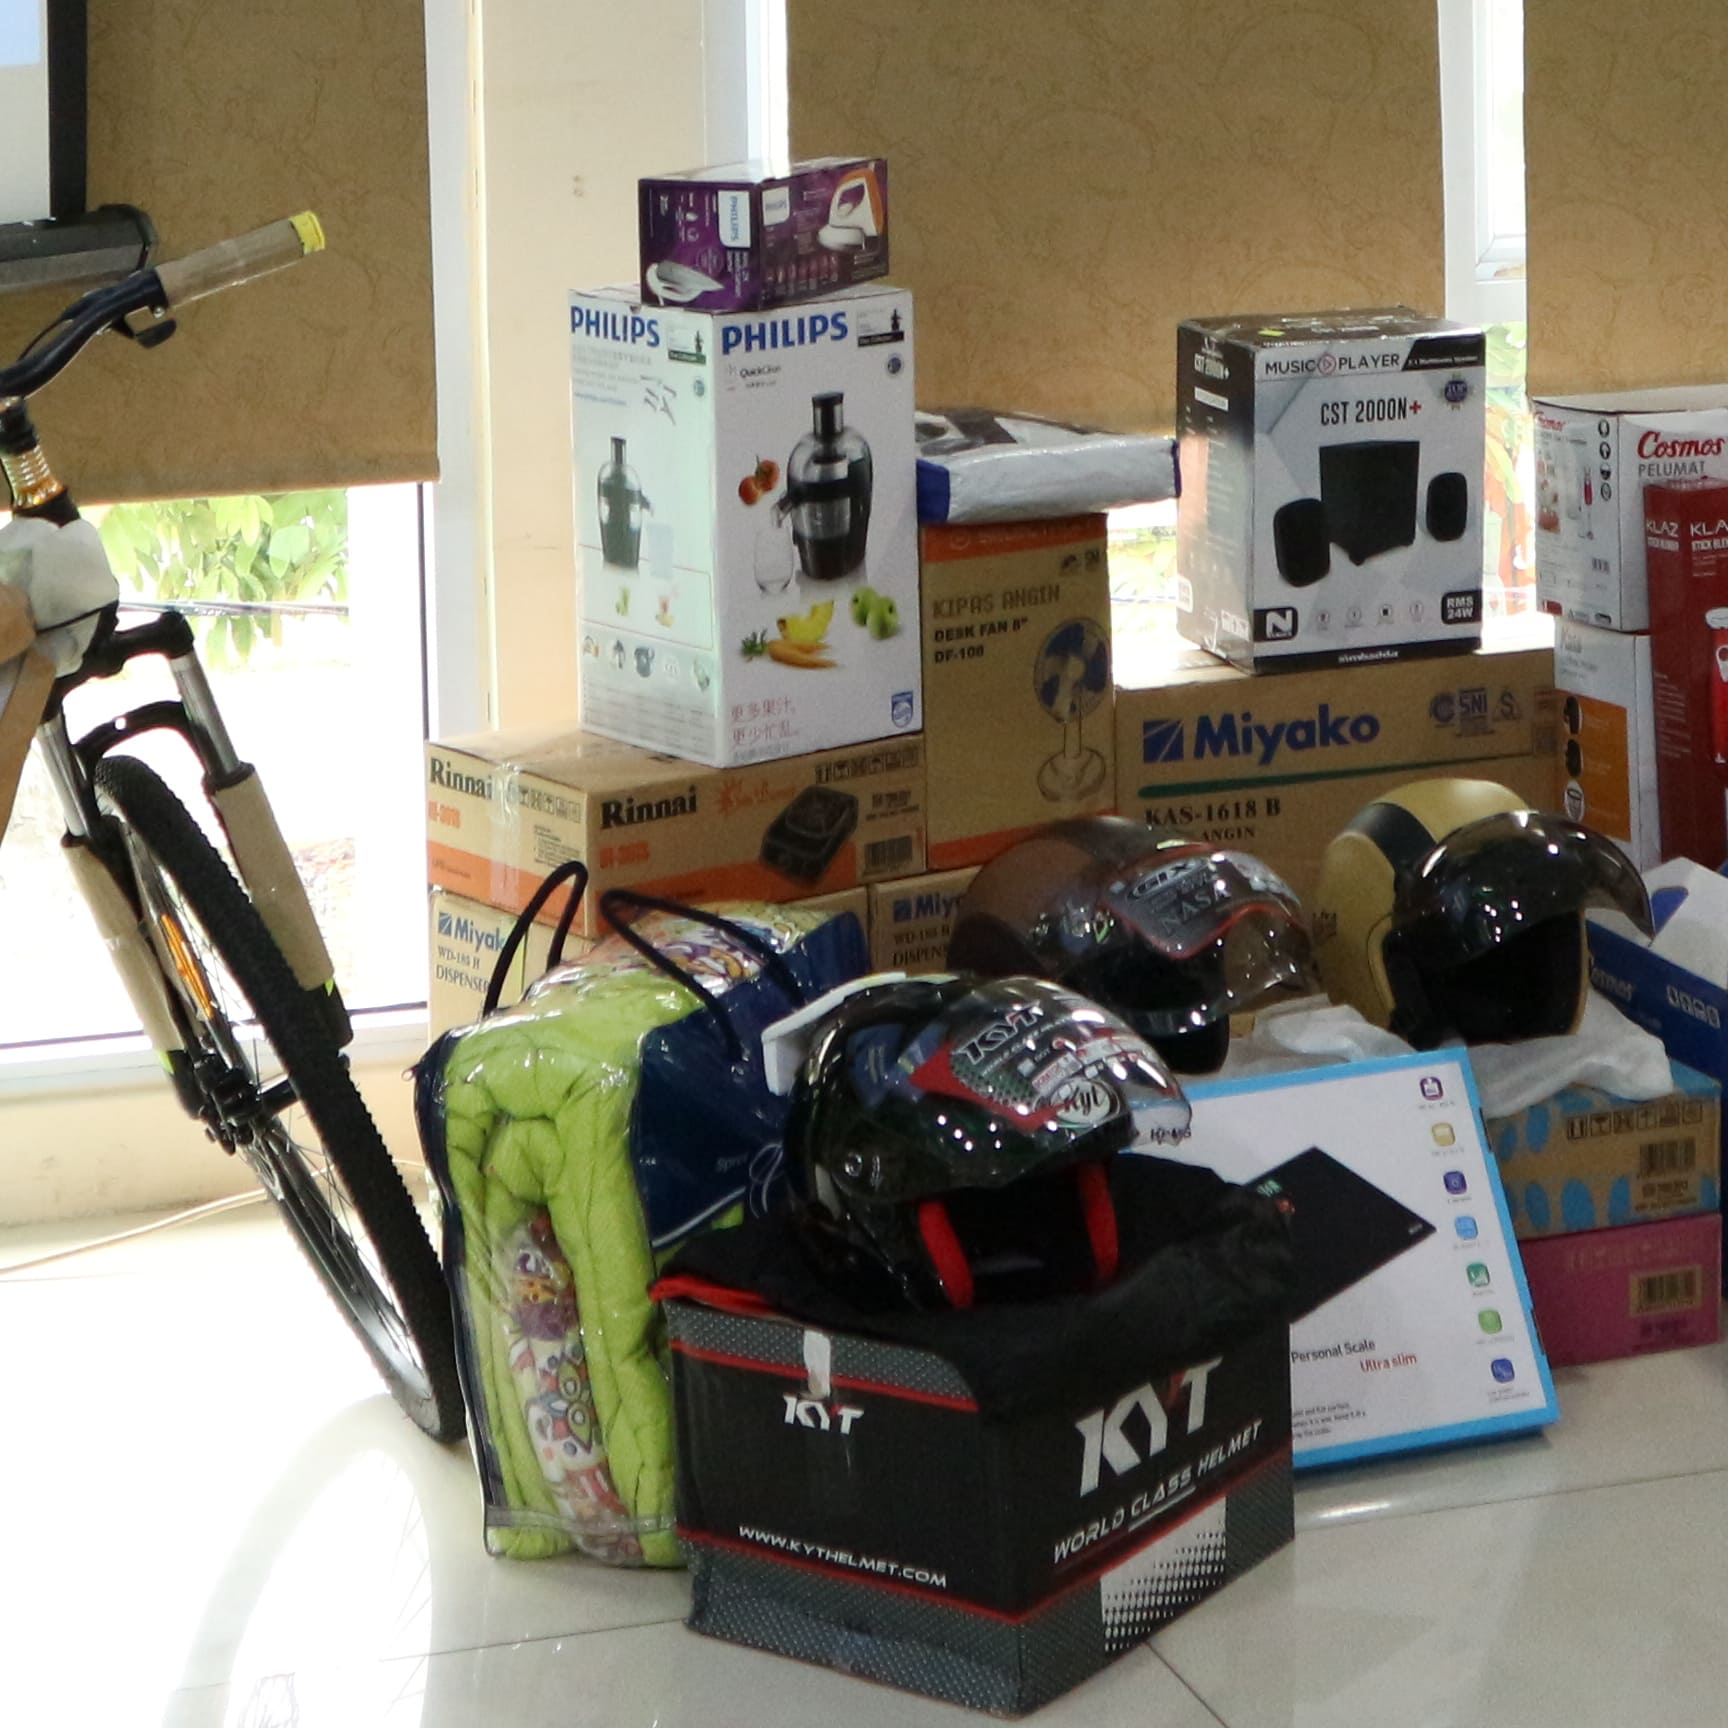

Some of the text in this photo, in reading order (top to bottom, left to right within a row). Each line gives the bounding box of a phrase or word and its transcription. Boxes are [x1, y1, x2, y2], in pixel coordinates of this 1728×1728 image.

[570, 304, 661, 348] PHILIPS
[722, 311, 849, 355] PHILIPS
[1265, 352, 1400, 375] MUSIC PLAYER
[1320, 400, 1349, 426] CST
[1636, 430, 1726, 459] Cosmos
[1638, 460, 1706, 477] PELUMAT
[1646, 518, 1679, 538] KLAZ
[933, 584, 1061, 620] KIPAS ANGIN
[934, 625, 975, 643] DESK
[980, 621, 1008, 636] FAN
[1192, 703, 1381, 767] Miyako
[429, 756, 493, 801] Rinnai
[600, 784, 698, 830] Rinnai
[1144, 800, 1259, 827] KAS-1618
[1200, 825, 1256, 843] ANGIN
[454, 916, 508, 953] Miyak
[893, 944, 949, 968] DISPENS
[952, 999, 1042, 1066] KYT
[1291, 1338, 1376, 1364] Personal Scale
[1359, 1353, 1418, 1373] Ultra slim
[782, 1393, 865, 1435] KYT
[1075, 1356, 1223, 1497] KYT
[1052, 1503, 1126, 1565] WORLD
[1128, 1469, 1194, 1519] CLASS
[1195, 1418, 1264, 1477] HELMET
[737, 1525, 948, 1588] WWW.KYTHELMET.COM
